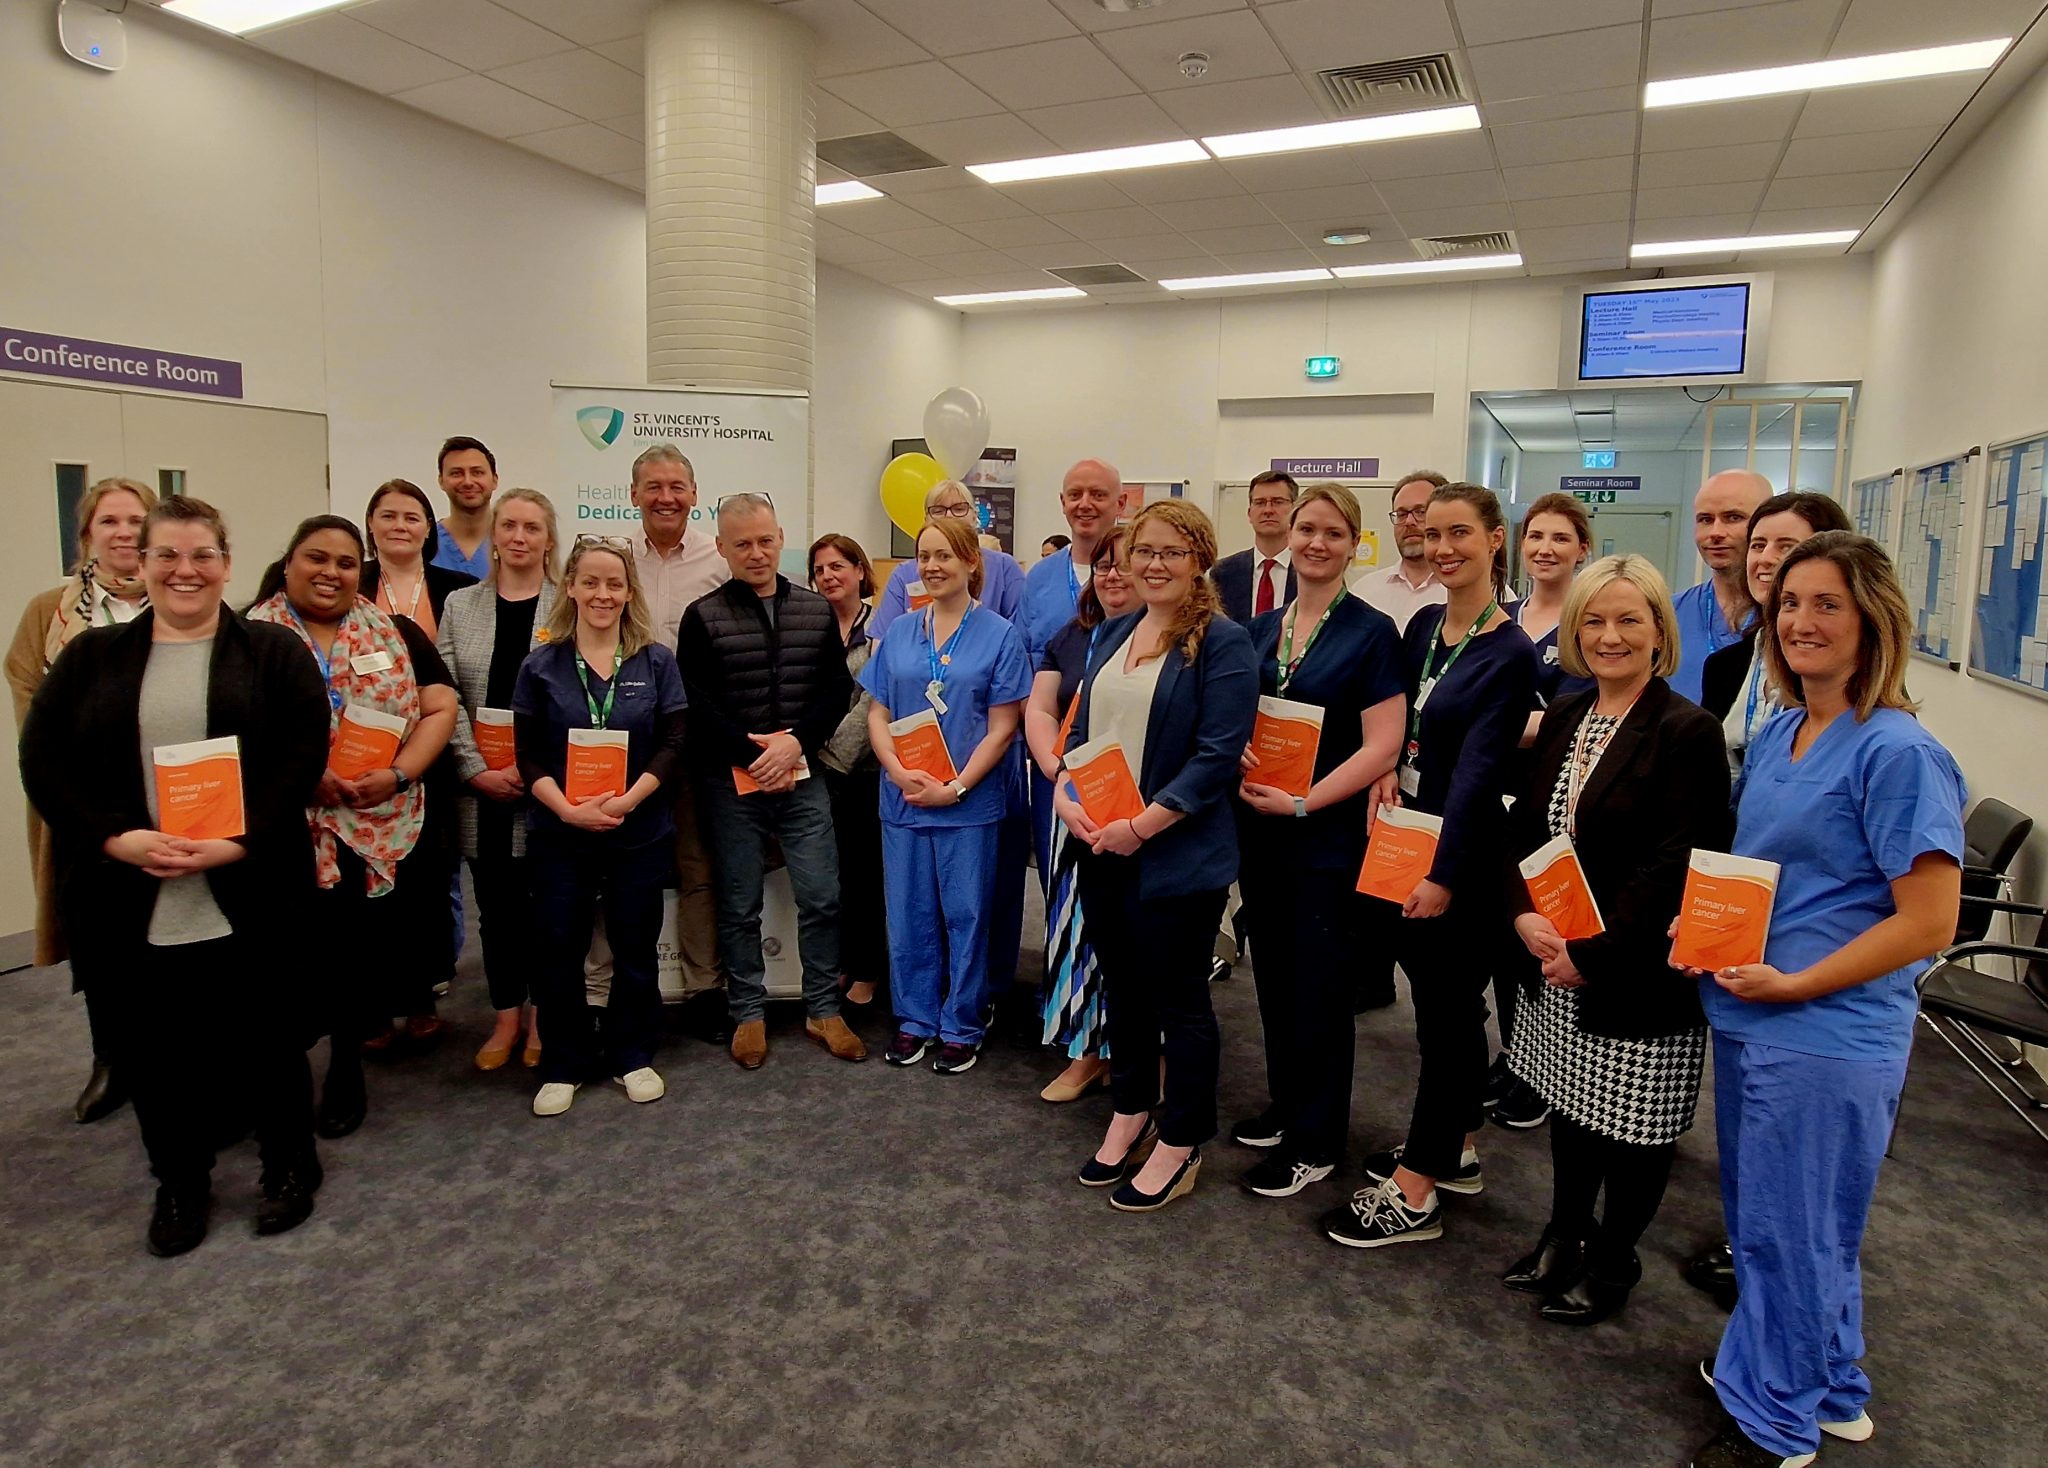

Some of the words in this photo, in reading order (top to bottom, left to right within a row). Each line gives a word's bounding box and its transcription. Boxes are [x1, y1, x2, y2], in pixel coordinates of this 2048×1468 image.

[4, 339, 149, 376] Conference
[156, 358, 219, 386] Room
[633, 413, 651, 424] ST.
[633, 426, 710, 438] UNIVERSITY
[714, 428, 774, 441] HOSPITAL
[1287, 462, 1333, 473] Lecture
[1336, 460, 1361, 473] Hall
[1568, 478, 1605, 487] Seminar
[1607, 479, 1633, 487] Room
[169, 783, 202, 794] Primary
[169, 793, 199, 804] cancer
[1375, 850, 1398, 860] cancer
[1377, 840, 1402, 854] Primary
[1403, 847, 1418, 857] liver
[1539, 888, 1560, 904] Primary
[1543, 898, 1561, 913] cancer
[1693, 896, 1726, 913] Primary
[1727, 903, 1747, 915] liver
[1691, 908, 1721, 920] cancer
